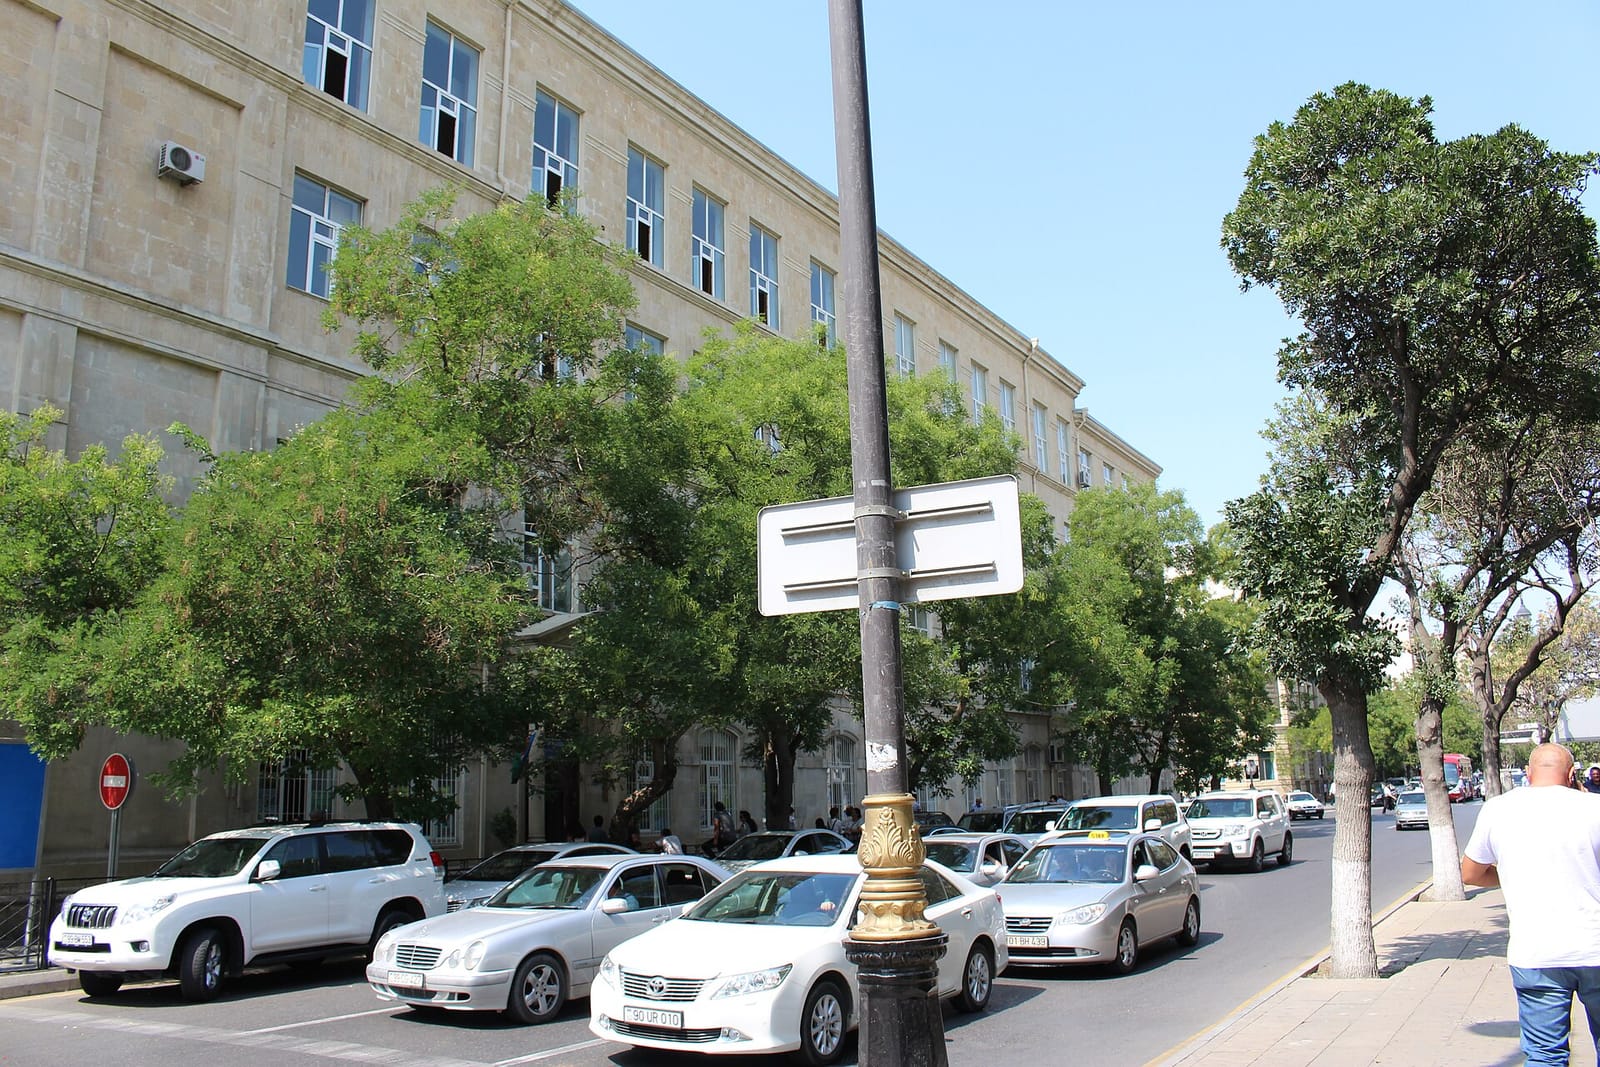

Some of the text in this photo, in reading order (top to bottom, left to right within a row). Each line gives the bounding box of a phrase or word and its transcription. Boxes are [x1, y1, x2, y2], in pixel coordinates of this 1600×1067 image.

[1008, 937, 1018, 945] 01
[633, 1010, 645, 1022] 90
[646, 1011, 659, 1024] UR
[660, 1013, 679, 1026] 010
